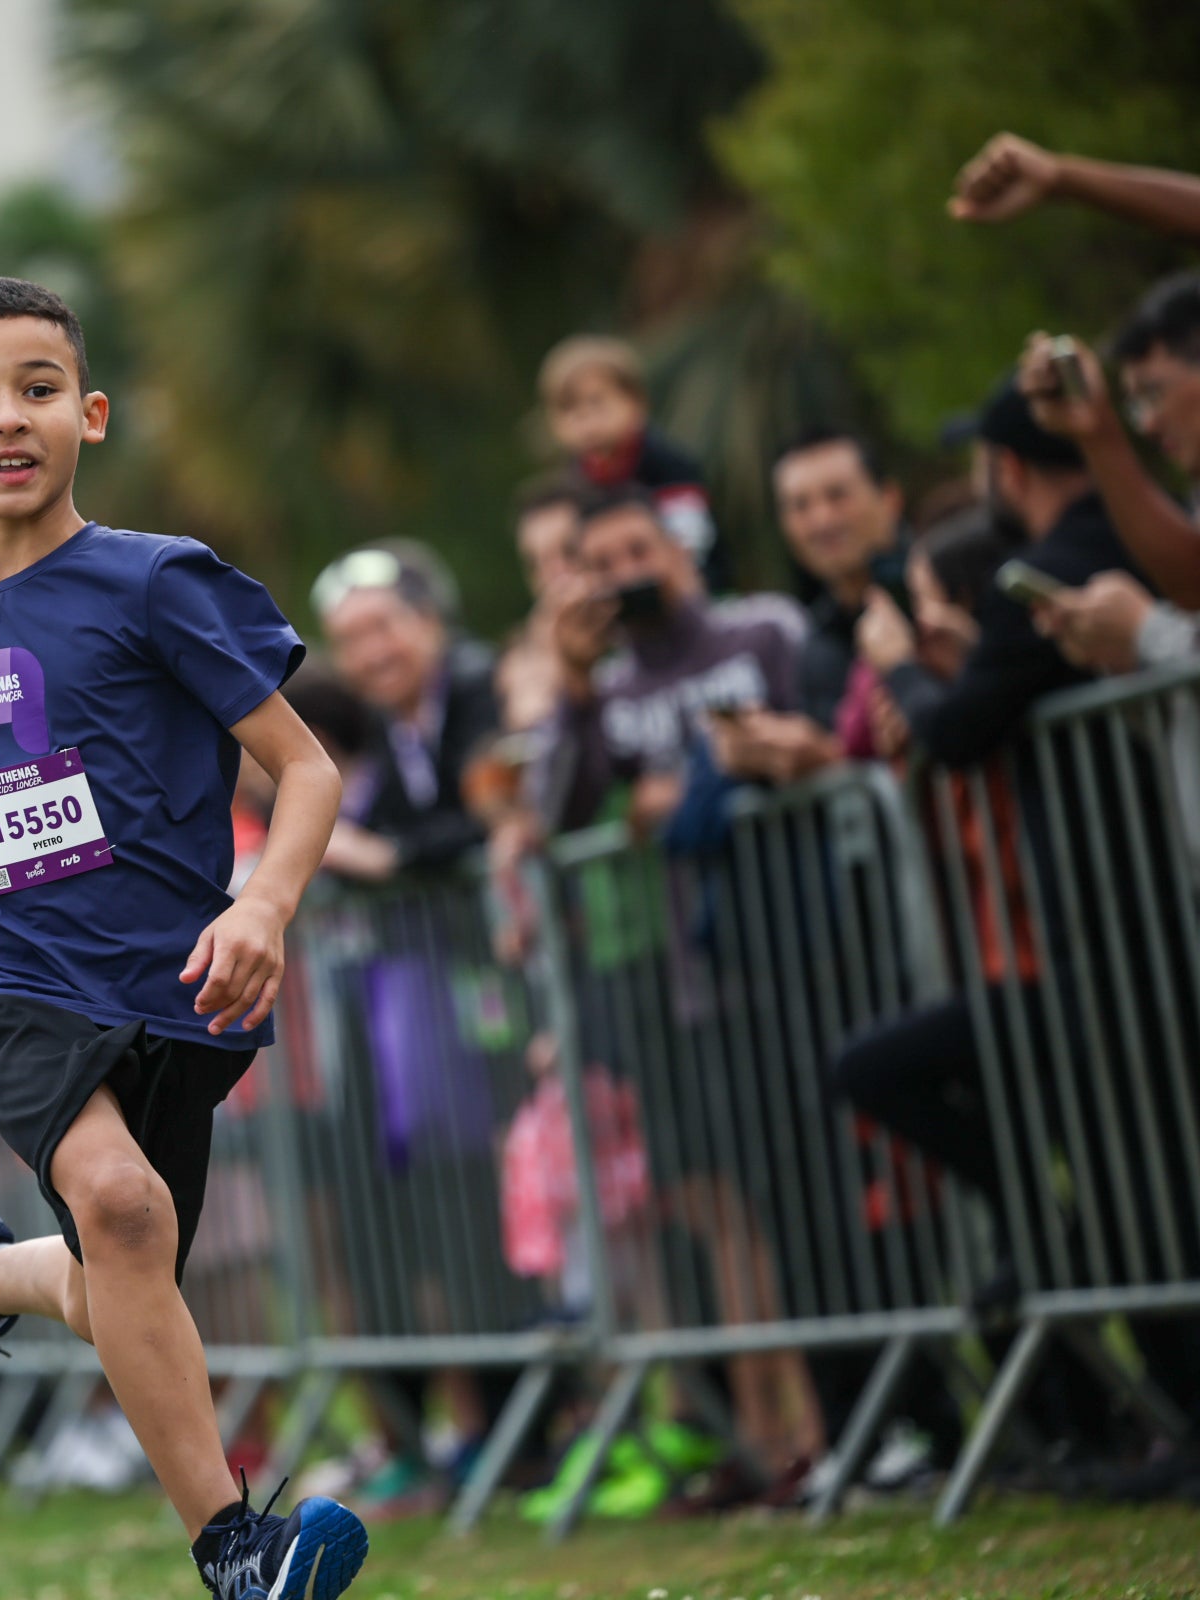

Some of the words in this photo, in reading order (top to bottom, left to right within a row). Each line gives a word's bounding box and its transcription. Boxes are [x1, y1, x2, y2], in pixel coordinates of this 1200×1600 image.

[16, 776, 44, 791] LONGER
[32, 835, 64, 851] PYETRO
[60, 853, 81, 868] rvb
